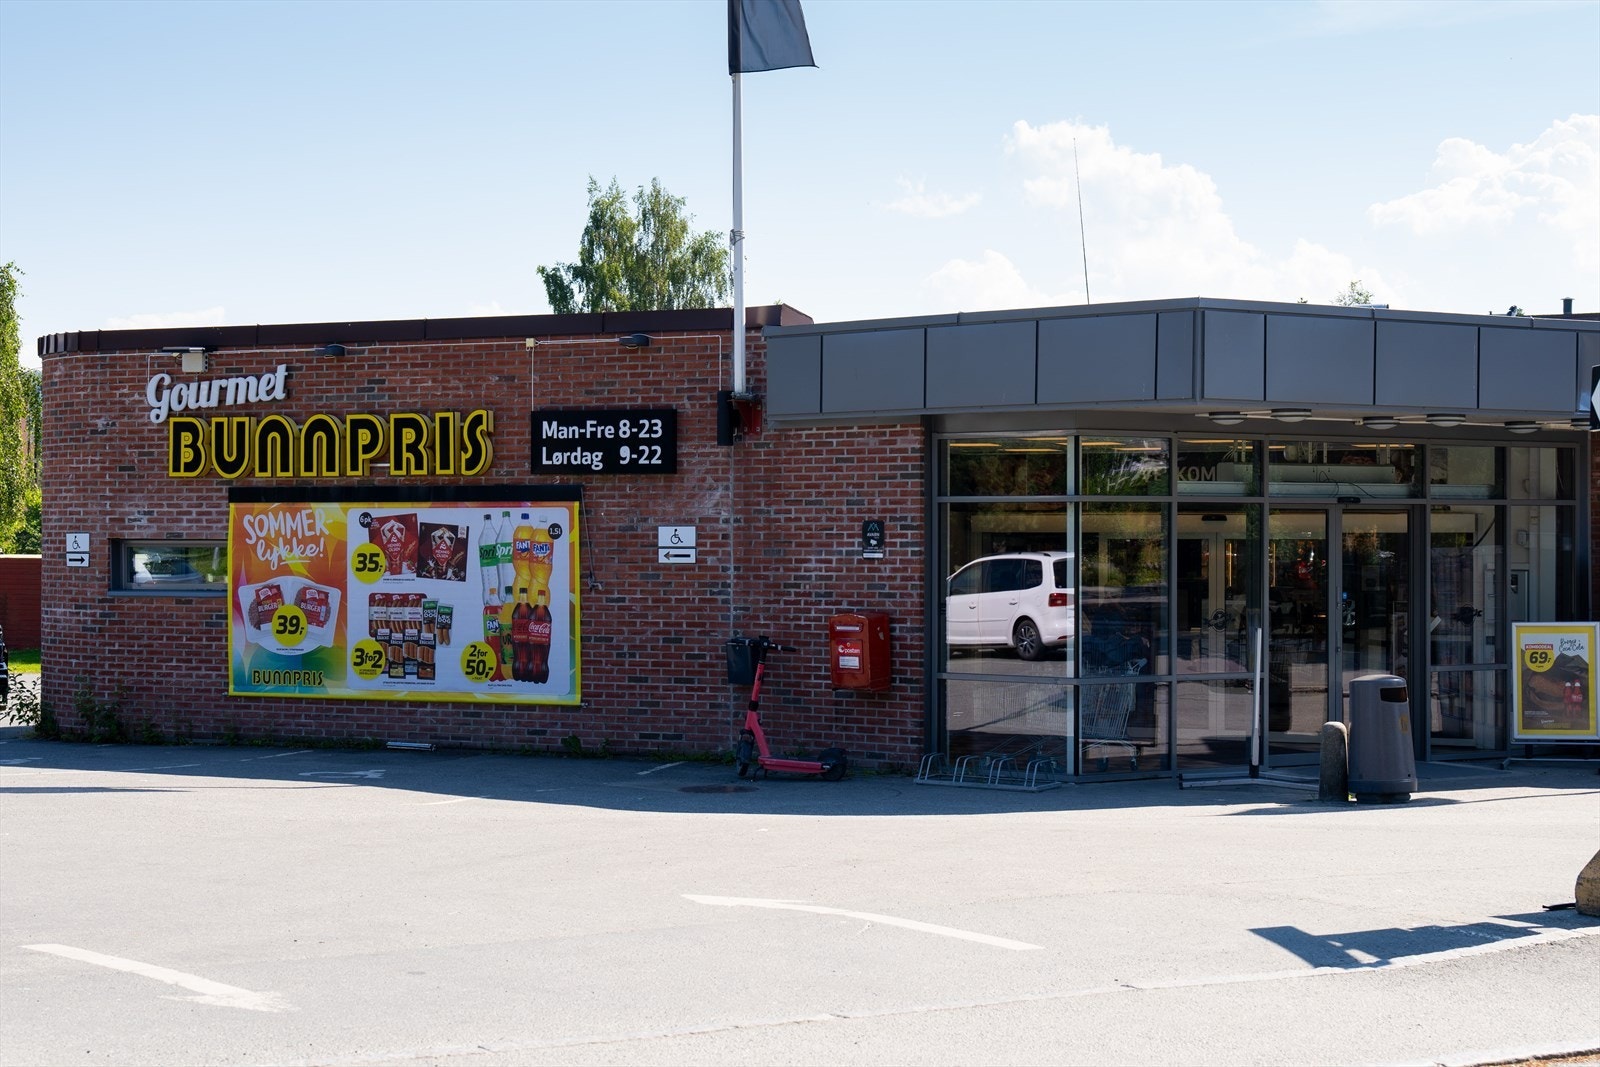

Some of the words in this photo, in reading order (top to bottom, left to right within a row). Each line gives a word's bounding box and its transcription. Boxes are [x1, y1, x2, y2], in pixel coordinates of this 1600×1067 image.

[146, 364, 288, 424] Gourmet
[542, 419, 615, 439] Man-Fre
[618, 419, 663, 438] 8-23
[169, 409, 494, 479] BUNNPRIS
[542, 446, 604, 470] Lørdag
[619, 445, 662, 465] 9-22
[243, 508, 333, 545] SOMMER-
[256, 537, 325, 571] lykke!
[480, 546, 496, 560] Spri
[496, 543, 513, 558] Spri
[300, 602, 321, 613] BURGER
[253, 670, 323, 686] BUNNPRIS
[465, 659, 494, 679] 50,-
